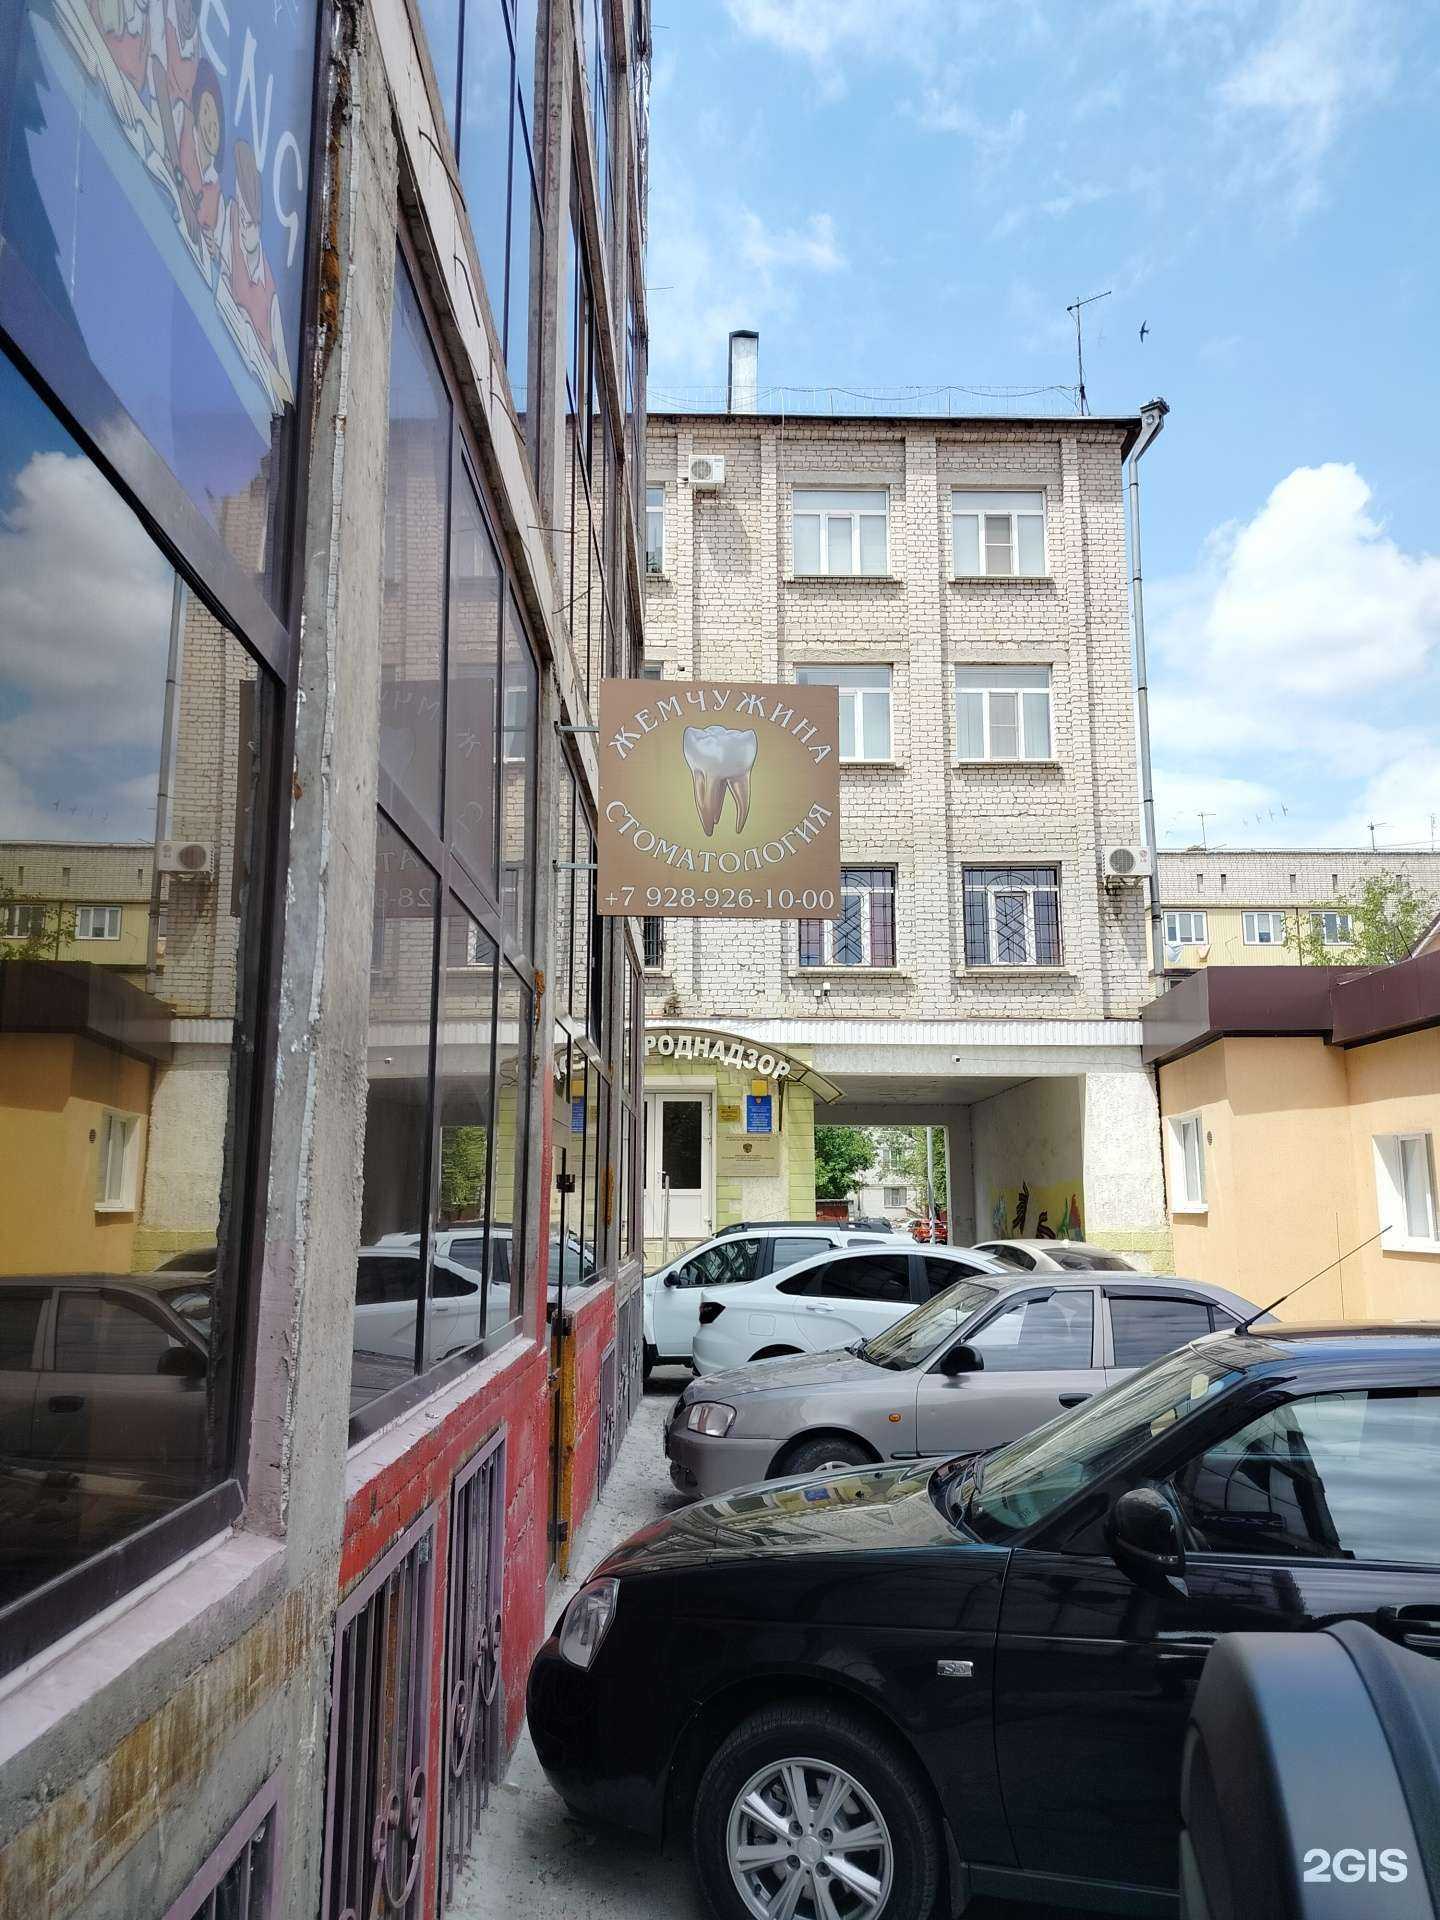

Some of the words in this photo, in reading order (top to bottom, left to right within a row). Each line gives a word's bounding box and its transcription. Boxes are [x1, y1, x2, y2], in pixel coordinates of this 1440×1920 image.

[609, 689, 832, 764] ЖЕМЧУЖИНА
[605, 800, 833, 873] СТОМАТОЛОГИЯ
[604, 886, 635, 907] +7
[646, 887, 835, 910] 928-926-10-00
